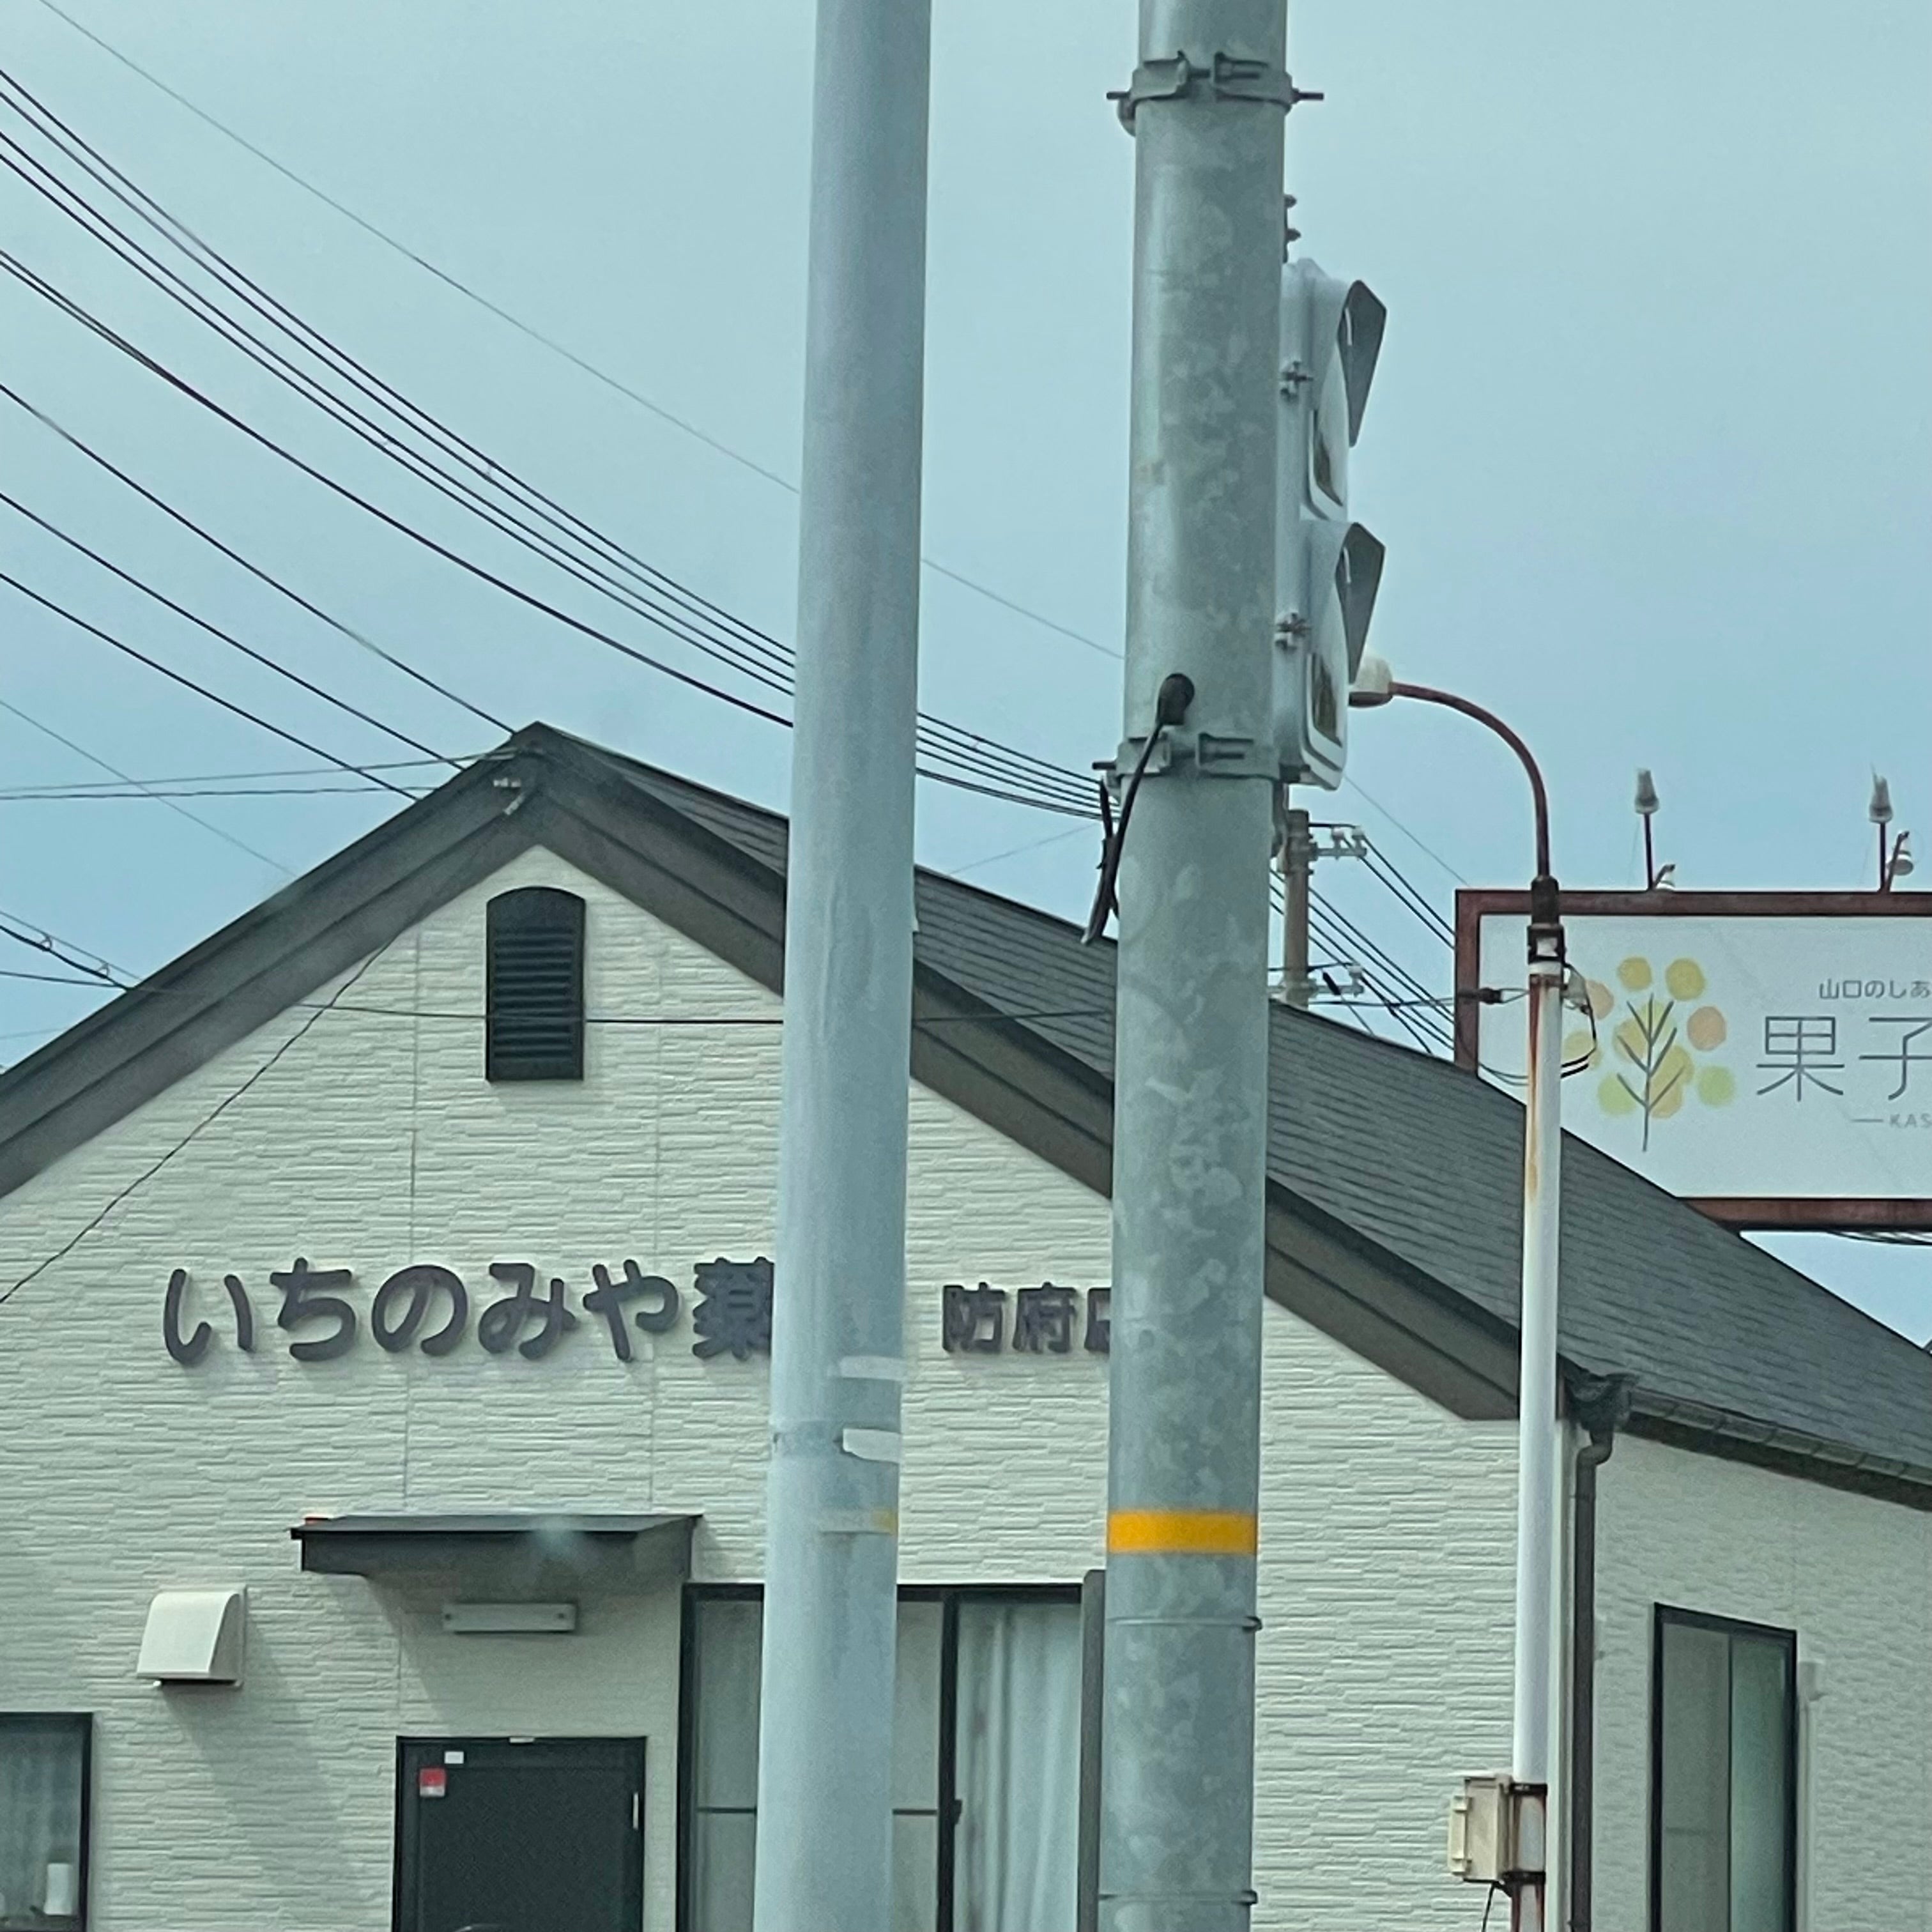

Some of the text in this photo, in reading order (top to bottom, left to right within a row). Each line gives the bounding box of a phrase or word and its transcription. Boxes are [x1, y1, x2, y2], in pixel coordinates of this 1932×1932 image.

[1820, 979, 1931, 999] 山口のしあ
[1756, 1016, 1932, 1102] 果子
